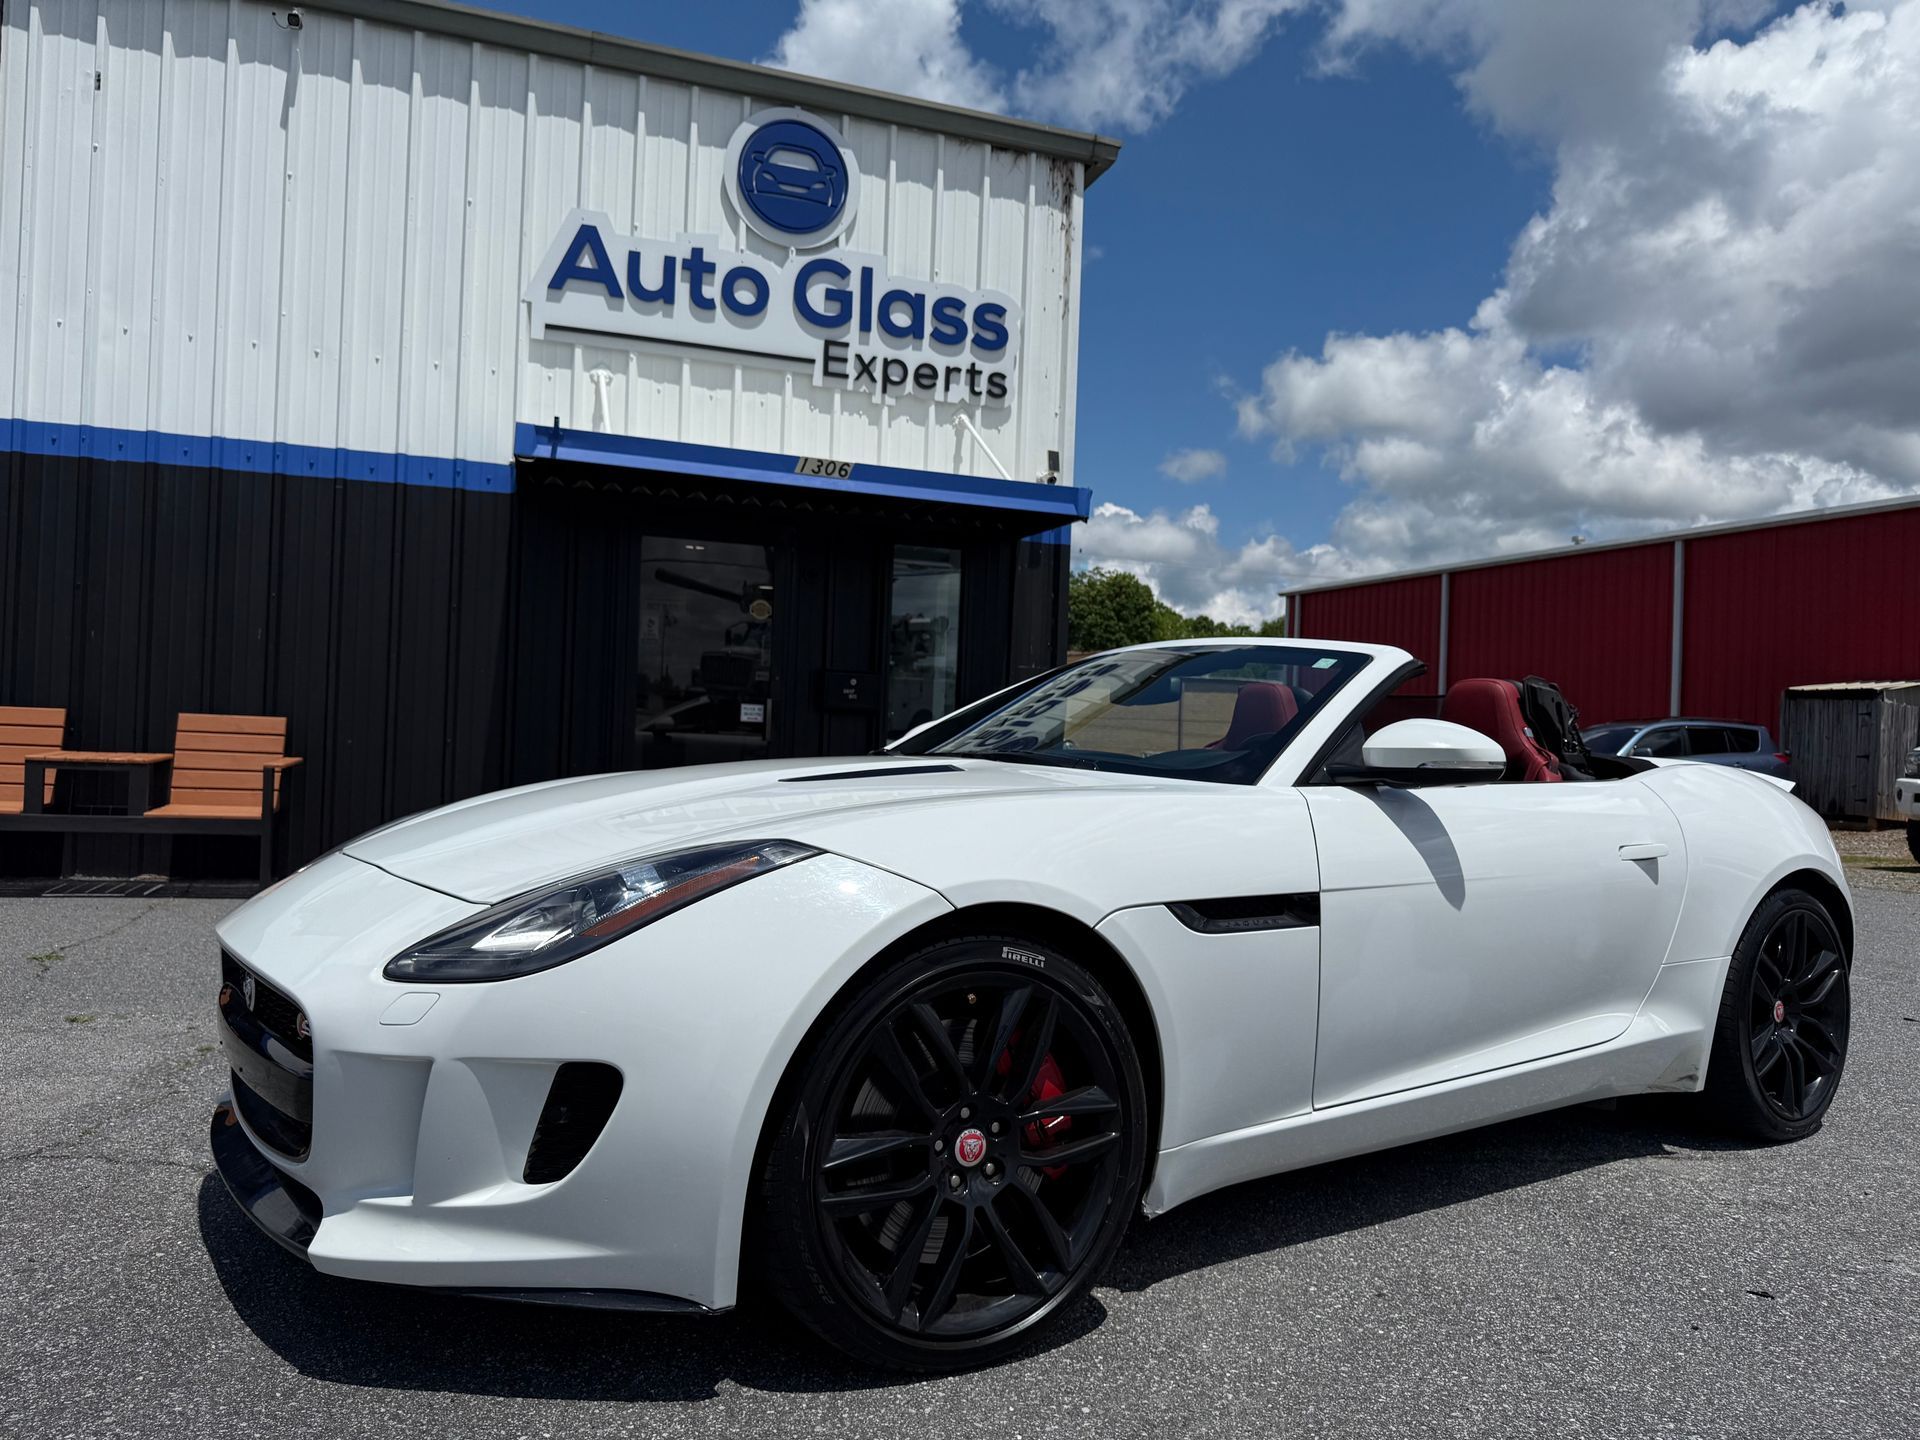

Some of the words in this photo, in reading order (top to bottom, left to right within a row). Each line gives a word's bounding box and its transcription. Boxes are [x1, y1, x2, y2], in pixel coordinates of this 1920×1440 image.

[548, 224, 770, 317] Auto
[794, 258, 1009, 351] Glass
[823, 340, 1008, 400] Experts
[800, 457, 851, 478] 1306
[1001, 946, 1046, 968] PIRELLI
